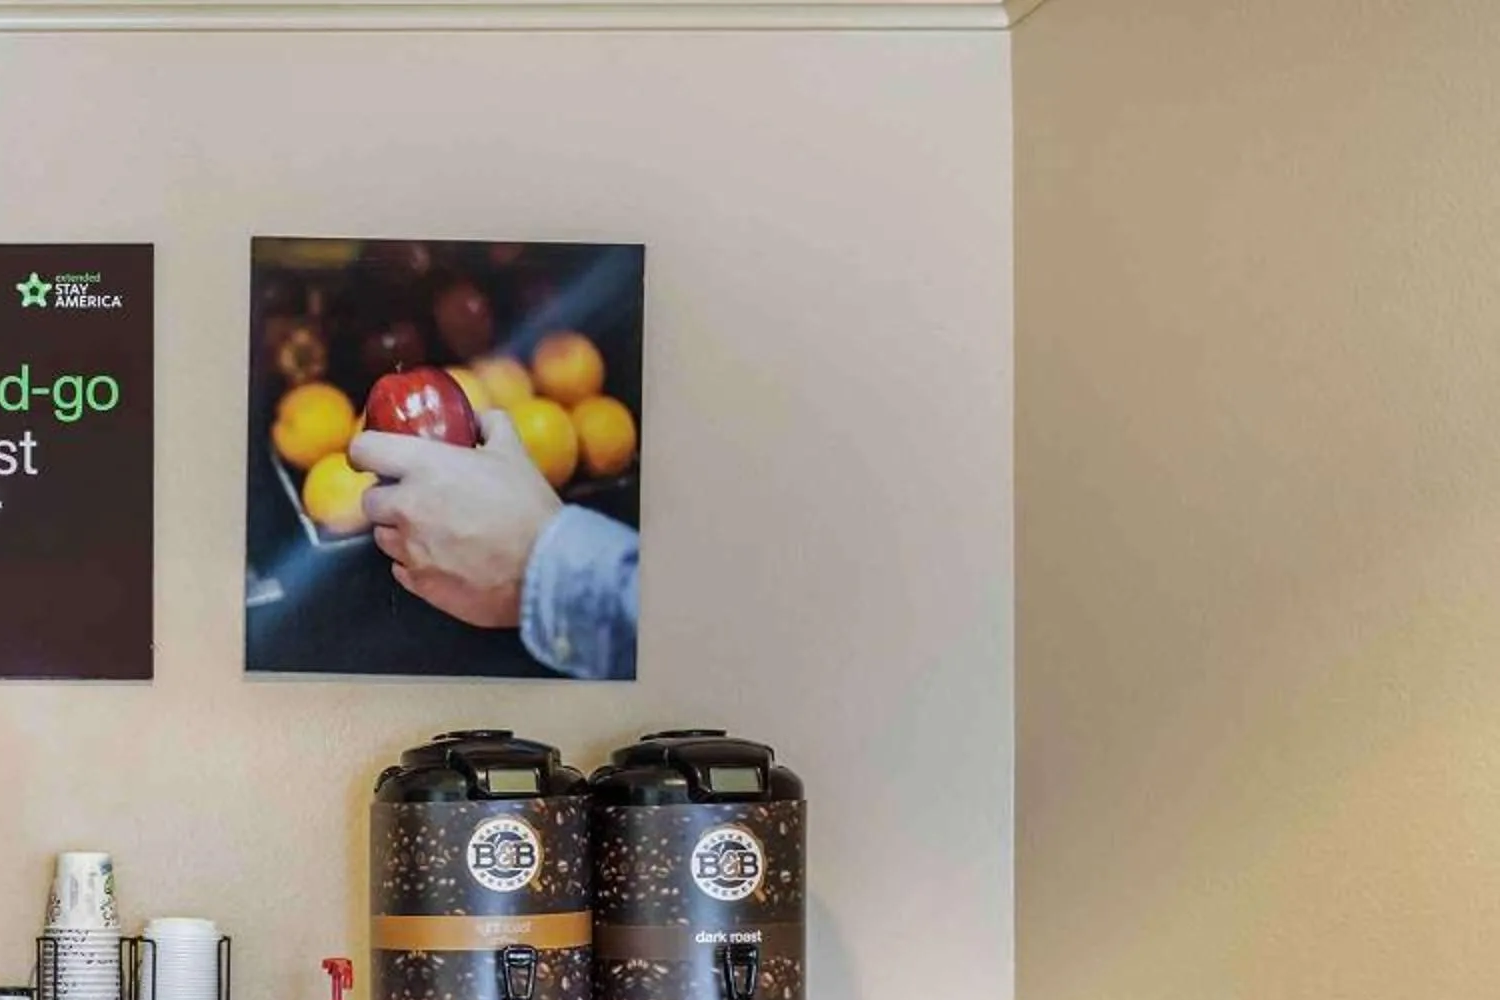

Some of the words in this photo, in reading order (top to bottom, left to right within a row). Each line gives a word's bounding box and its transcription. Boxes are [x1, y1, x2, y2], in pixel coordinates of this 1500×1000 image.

[55, 272, 101, 282] extended
[55, 283, 89, 295] STAY
[55, 296, 122, 308] AMERICA
[695, 930, 728, 943] dark
[729, 929, 763, 943] roast
